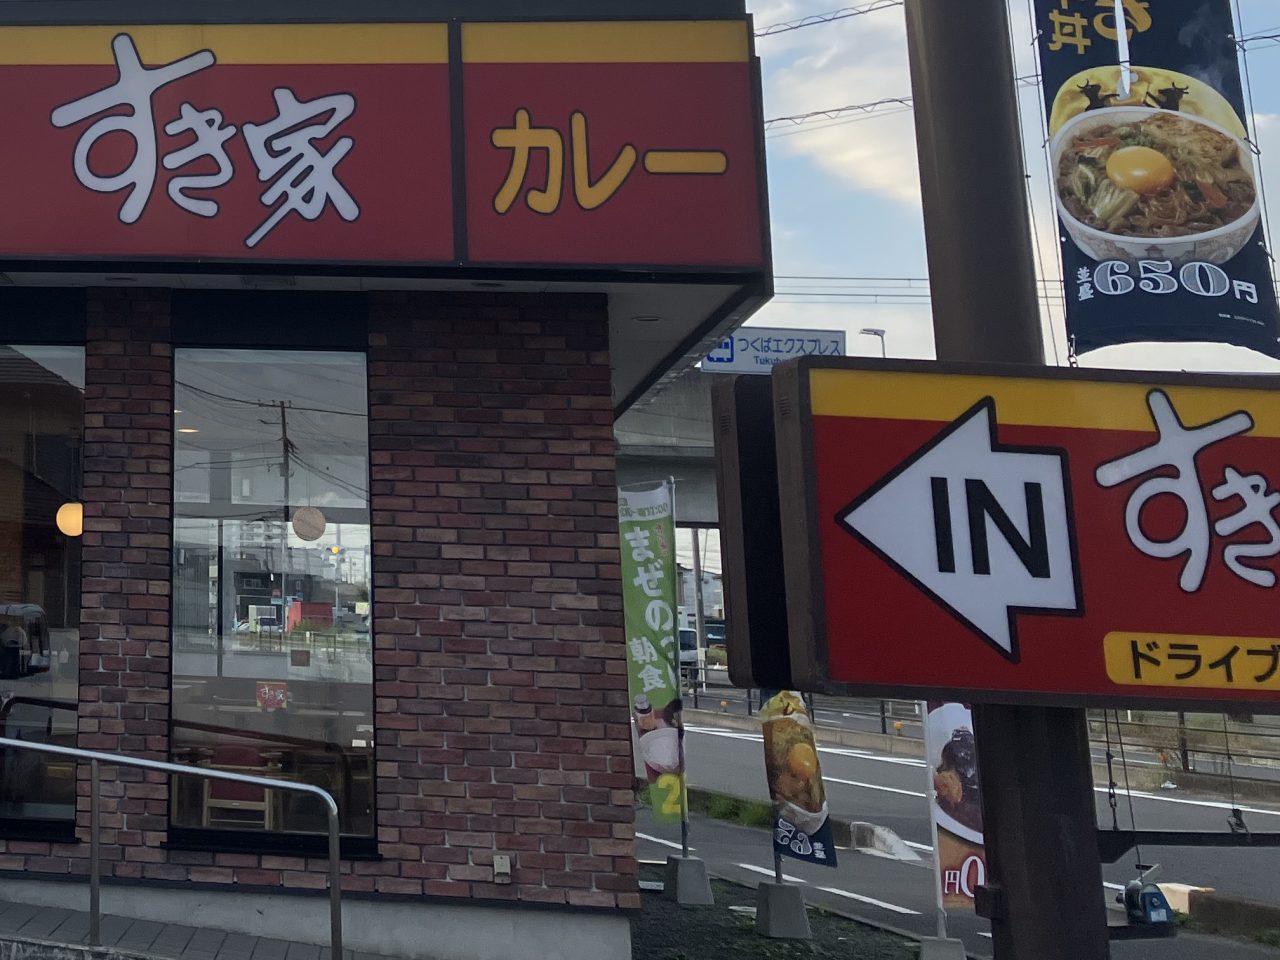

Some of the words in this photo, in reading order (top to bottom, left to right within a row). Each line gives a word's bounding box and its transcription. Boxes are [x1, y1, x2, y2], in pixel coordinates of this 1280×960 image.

[51, 34, 359, 249] すき家
[491, 109, 727, 215] カレー
[1093, 260, 1259, 304] 650円
[738, 336, 841, 356] つくばエクスプレス
[754, 356, 784, 366] Tukub
[930, 476, 1051, 579] IN
[628, 636, 666, 692] 朝食
[1131, 640, 1280, 683] ドライブ
